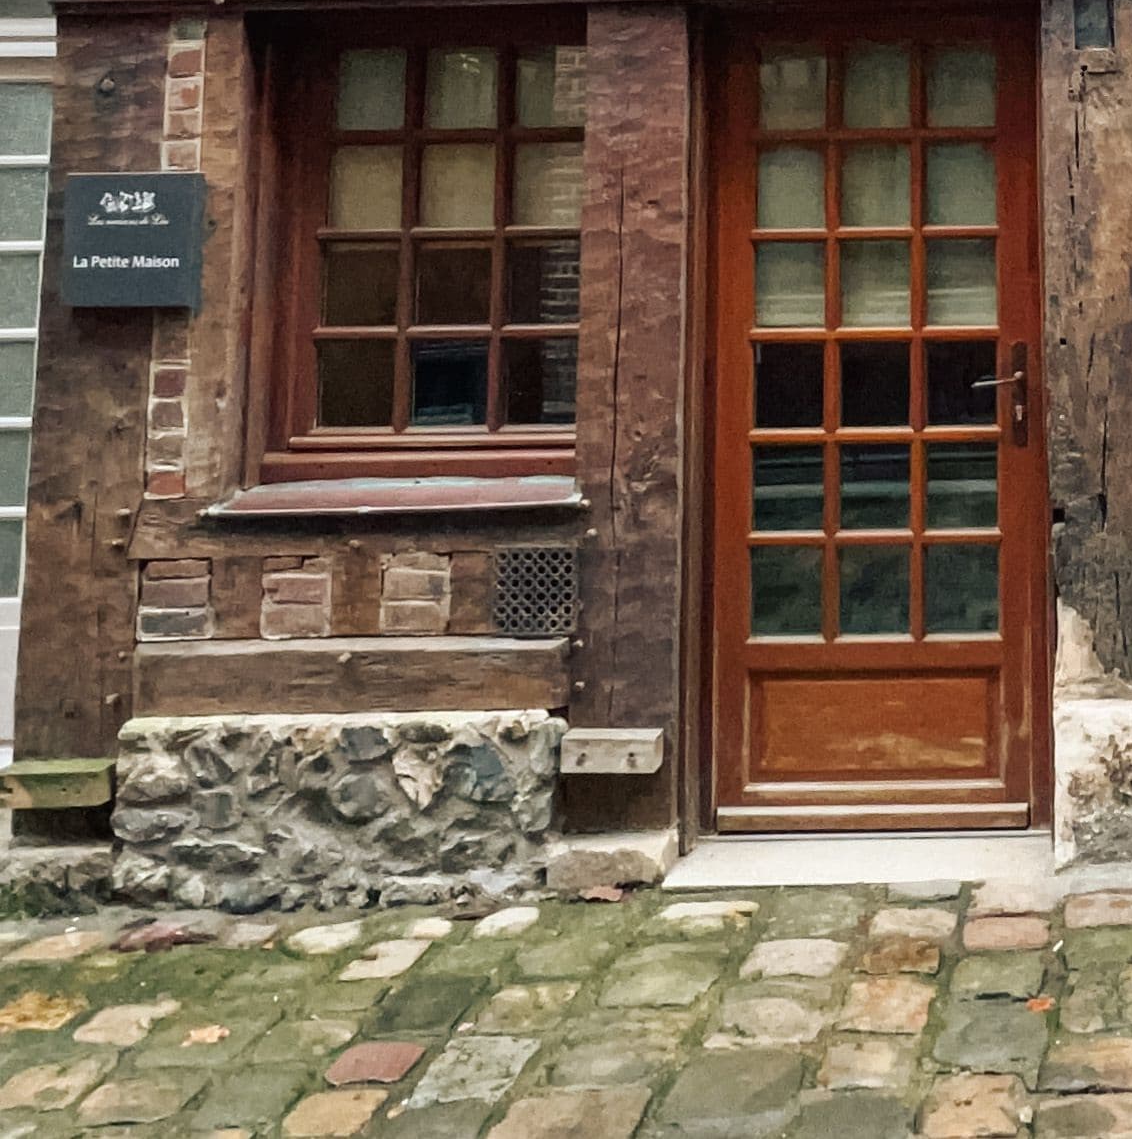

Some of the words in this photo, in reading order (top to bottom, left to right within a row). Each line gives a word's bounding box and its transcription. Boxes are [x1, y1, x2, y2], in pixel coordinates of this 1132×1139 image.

[73, 255, 88, 268] La
[91, 255, 130, 268] Petite
[131, 255, 179, 268] Maison
